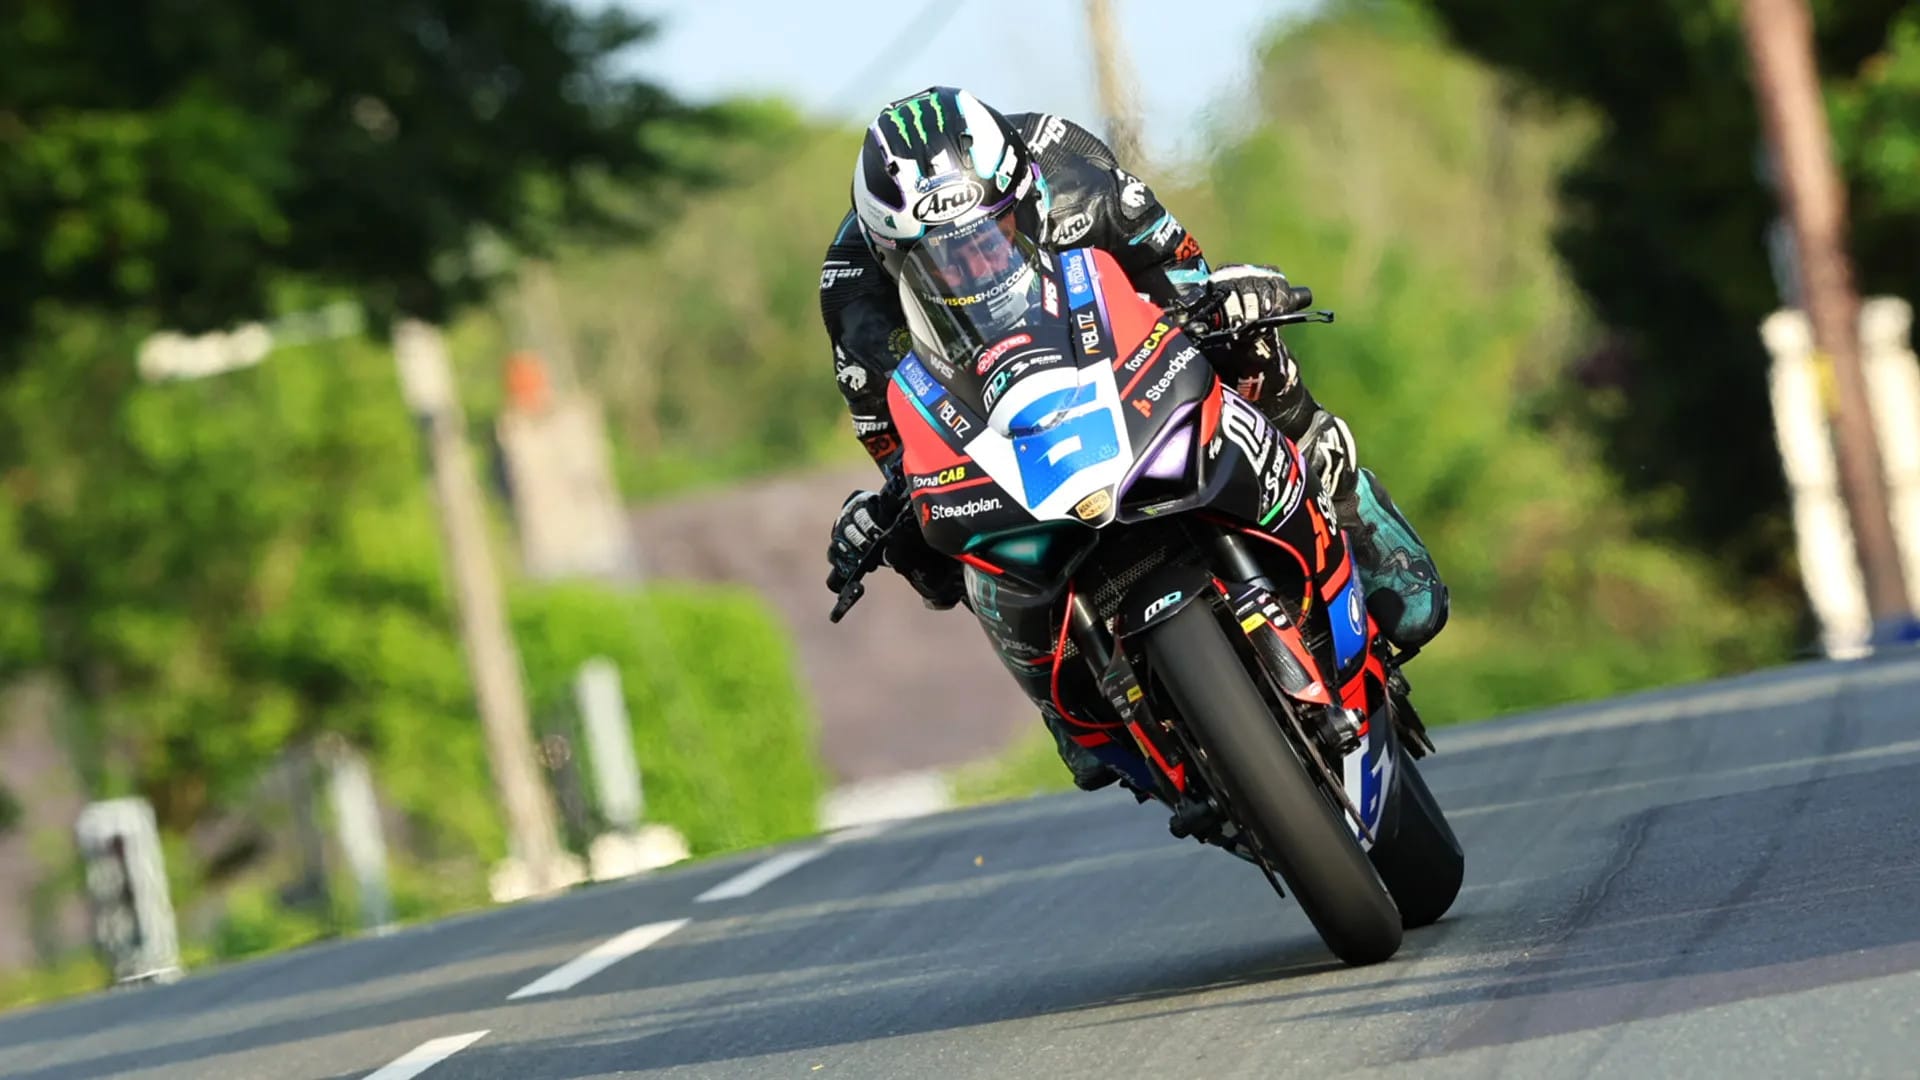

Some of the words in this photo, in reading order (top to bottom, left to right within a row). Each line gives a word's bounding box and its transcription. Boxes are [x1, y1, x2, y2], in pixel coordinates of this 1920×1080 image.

[918, 183, 976, 220] Arai
[1056, 213, 1091, 240] Arai
[1124, 322, 1170, 373] fonaCAB
[1008, 381, 1120, 510] 6
[912, 466, 966, 489] fonaCAB
[931, 498, 1003, 520] Steadplan.
[1144, 590, 1183, 622] MD
